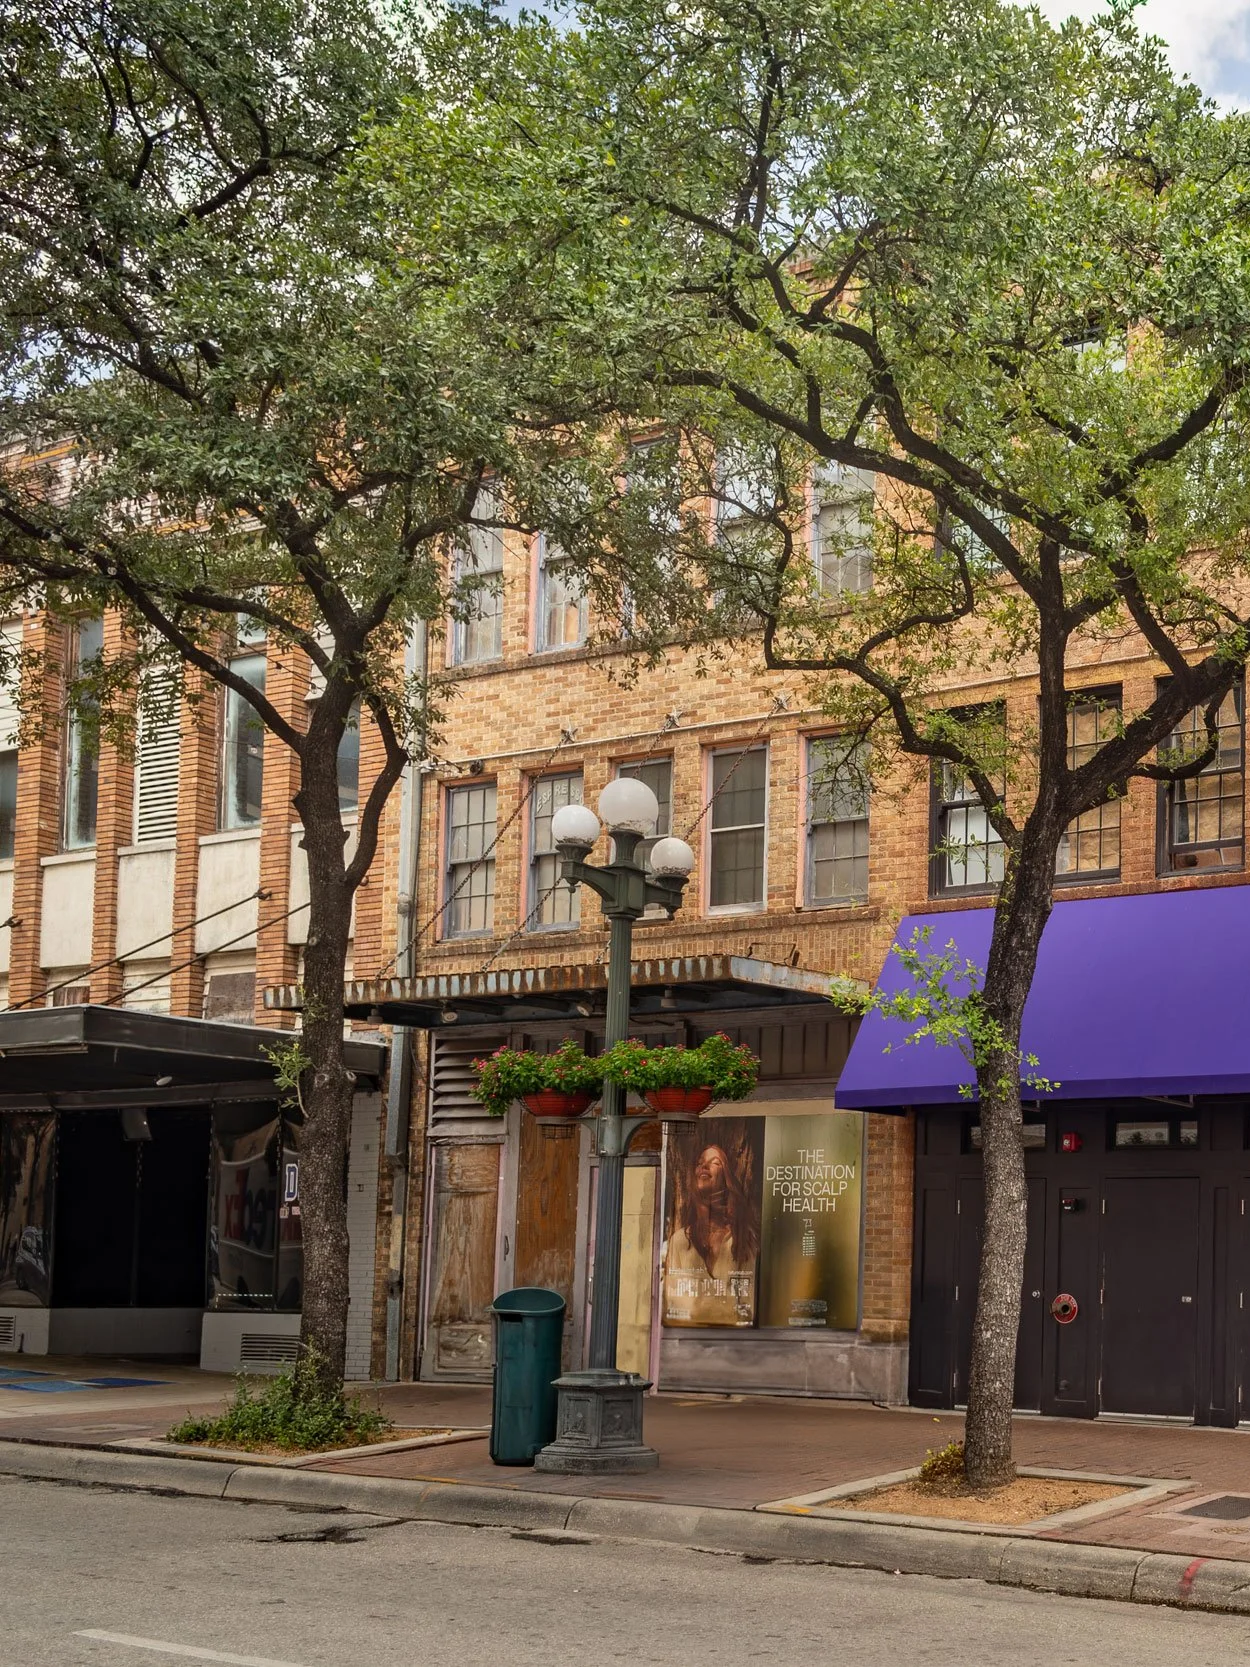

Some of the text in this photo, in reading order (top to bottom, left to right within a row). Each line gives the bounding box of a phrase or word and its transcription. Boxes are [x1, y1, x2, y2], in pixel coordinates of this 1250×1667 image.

[798, 1149, 825, 1164] THE
[766, 1165, 855, 1181] DESTINATION
[772, 1181, 848, 1196] FOR SCALP
[782, 1197, 836, 1213] HEALTH
